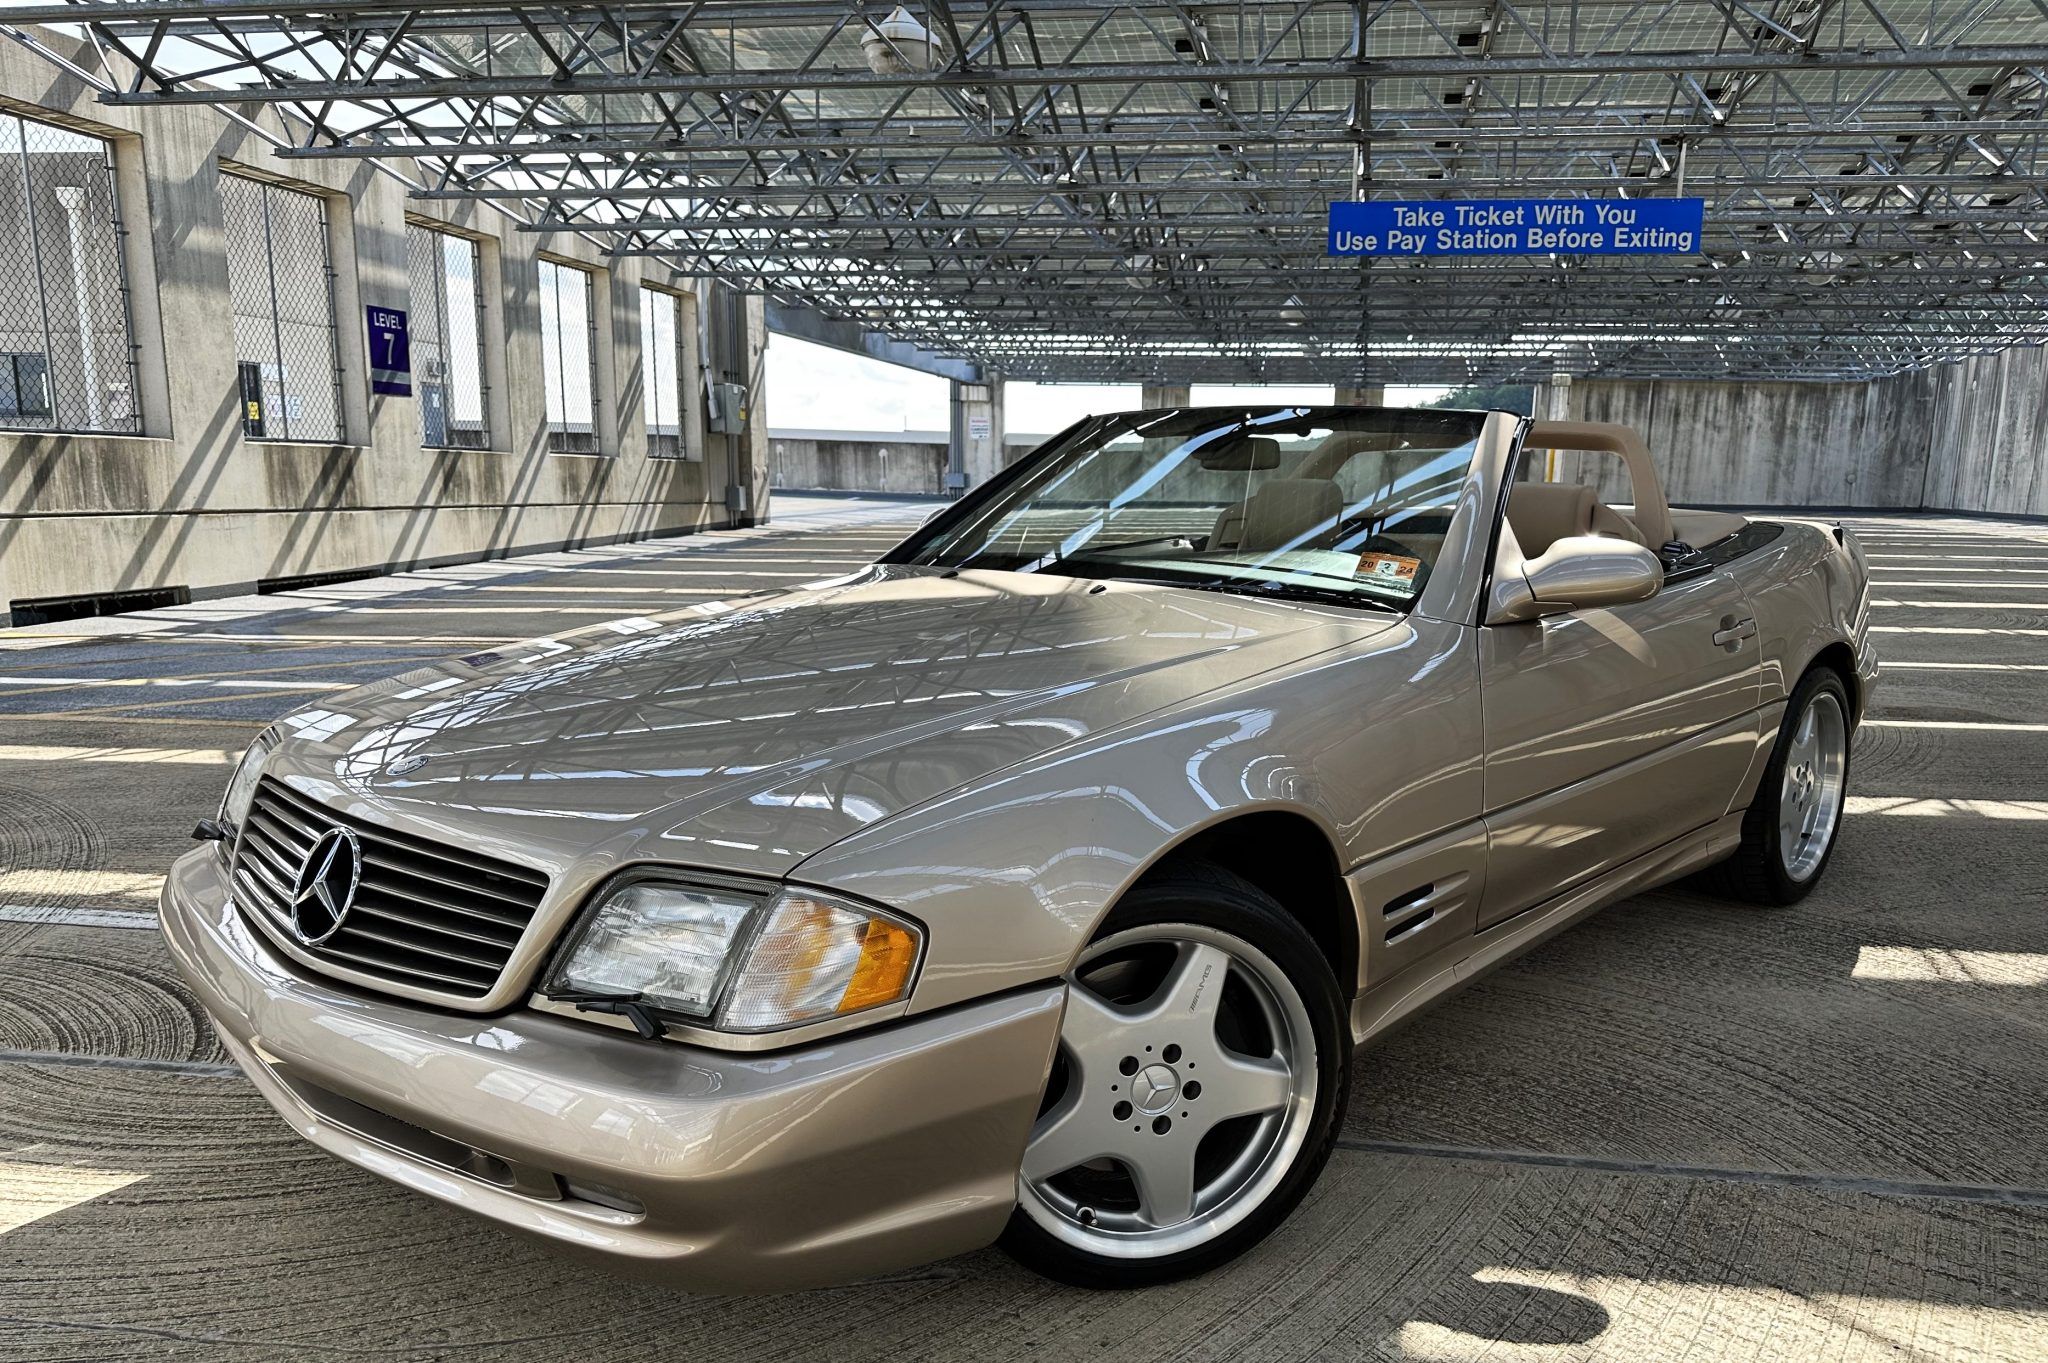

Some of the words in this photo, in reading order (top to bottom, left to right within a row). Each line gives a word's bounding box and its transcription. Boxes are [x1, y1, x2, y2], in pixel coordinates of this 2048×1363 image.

[1393, 206, 1445, 227] Take
[1455, 205, 1525, 226] Ticket
[1534, 204, 1585, 225] With
[1595, 204, 1636, 225] You
[1336, 231, 1377, 251] Use
[1387, 230, 1427, 254] Pay
[1436, 229, 1517, 250] Station
[1527, 228, 1604, 248] Before
[1614, 227, 1693, 252] Exiting
[373, 311, 402, 330] LEVEL
[383, 332, 395, 365] 7
[1360, 560, 1374, 569] 20
[1398, 566, 1414, 574] 24
